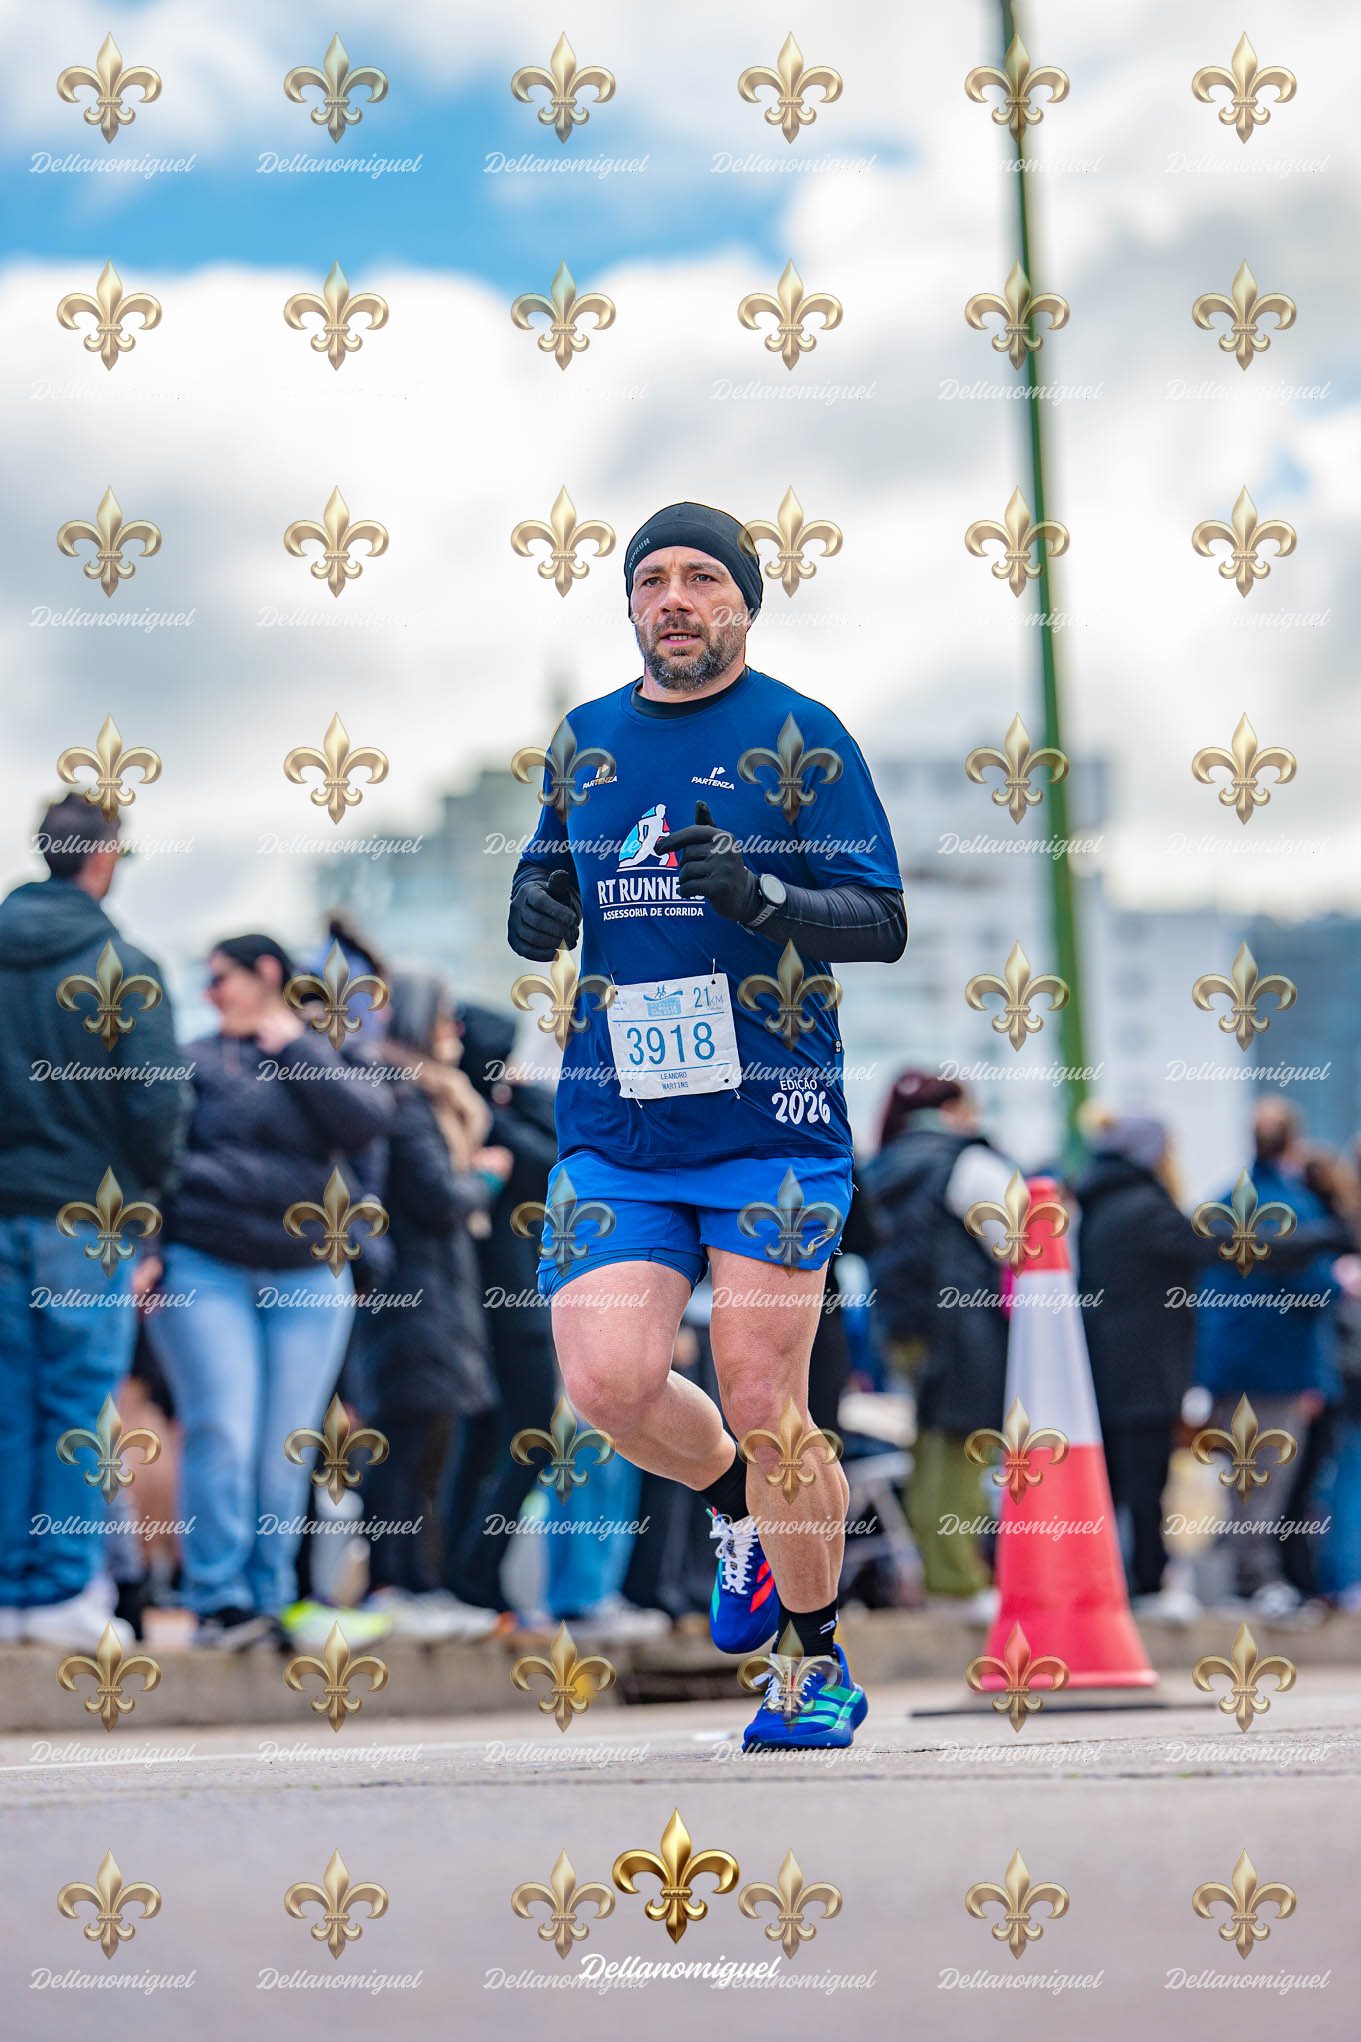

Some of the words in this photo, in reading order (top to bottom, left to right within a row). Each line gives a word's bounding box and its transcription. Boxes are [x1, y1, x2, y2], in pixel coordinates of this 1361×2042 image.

[691, 776, 735, 790] PARTENZA
[597, 879, 616, 905] RT
[603, 907, 648, 921] ASSESSORIA
[650, 907, 663, 917] DE
[664, 907, 704, 917] CORRIDA
[626, 1021, 716, 1066] 3918
[780, 1077, 818, 1092] EDIÇÃO
[771, 1090, 831, 1125] 2026
